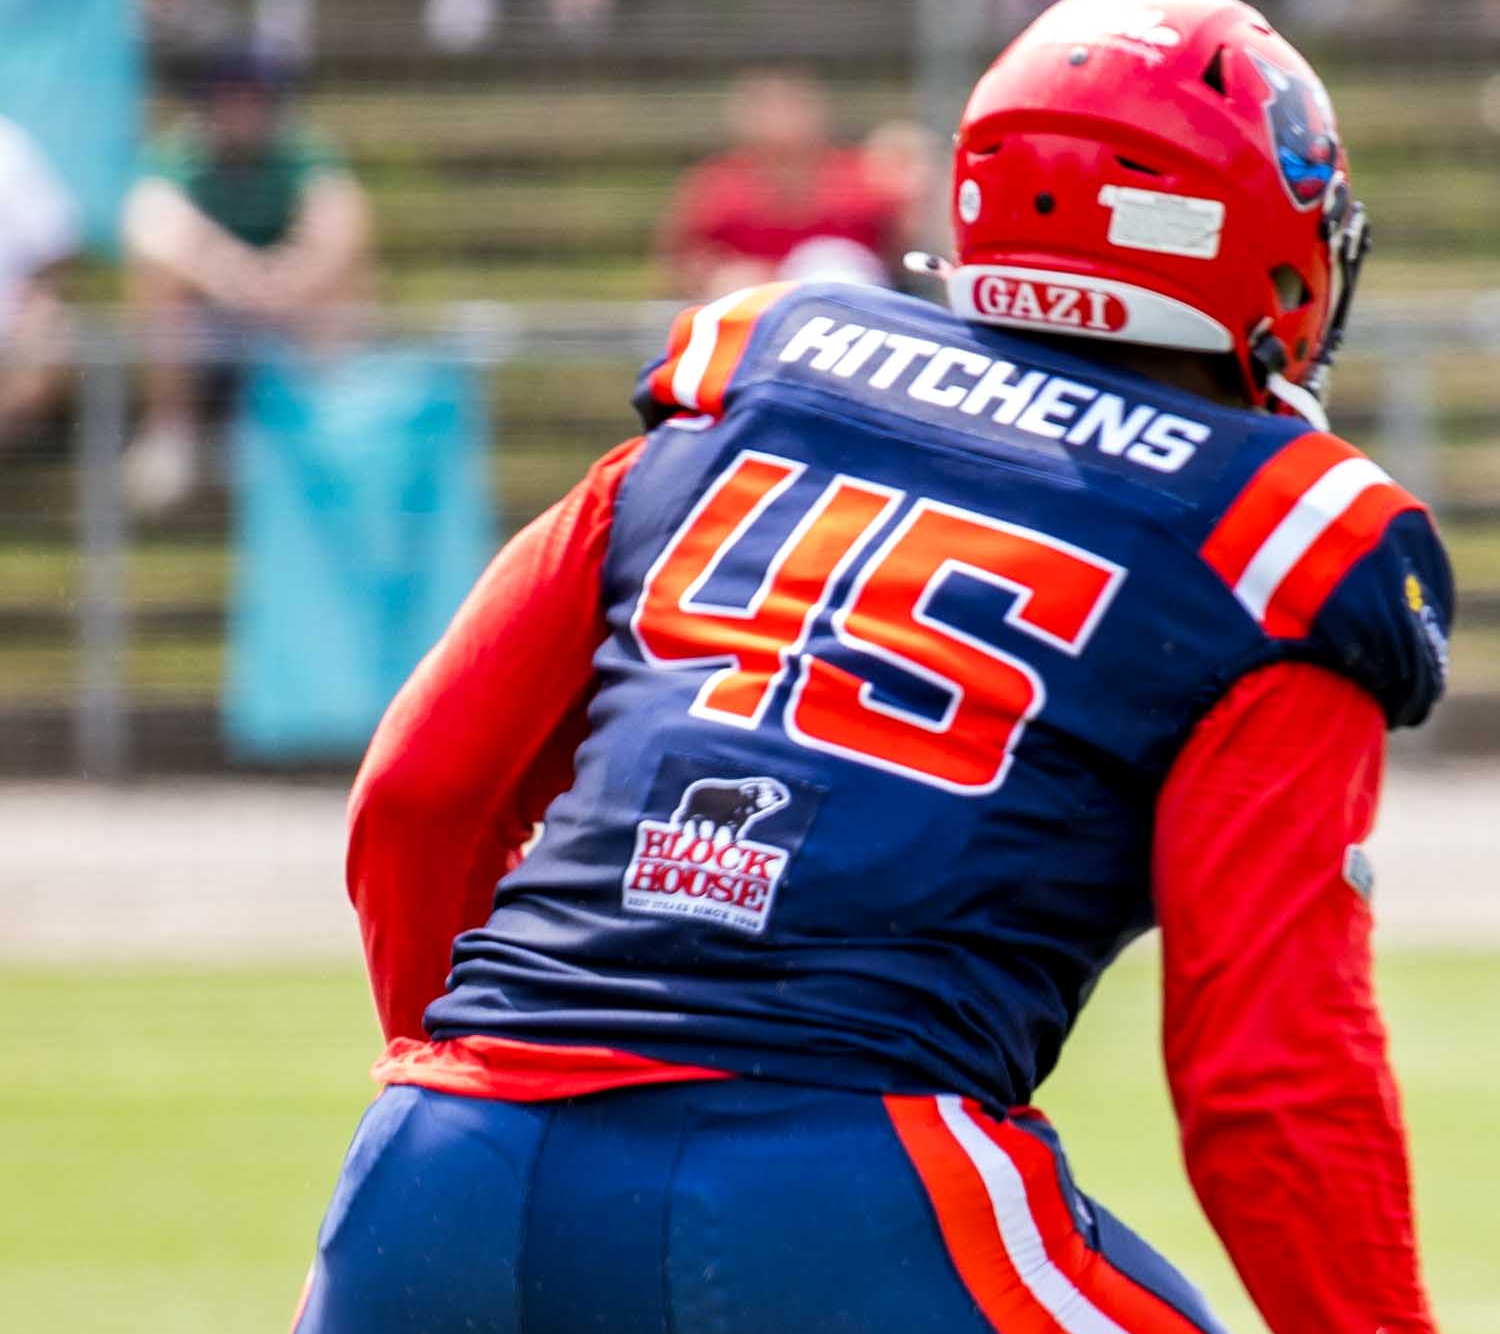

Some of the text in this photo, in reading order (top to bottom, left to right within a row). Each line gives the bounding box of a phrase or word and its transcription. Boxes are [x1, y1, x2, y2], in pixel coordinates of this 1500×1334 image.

[978, 275, 1112, 332] GAZI
[777, 315, 1212, 474] KITCHENS
[632, 449, 1128, 796] 45
[639, 828, 781, 880] BLOCK
[629, 860, 769, 913] HOUSE
